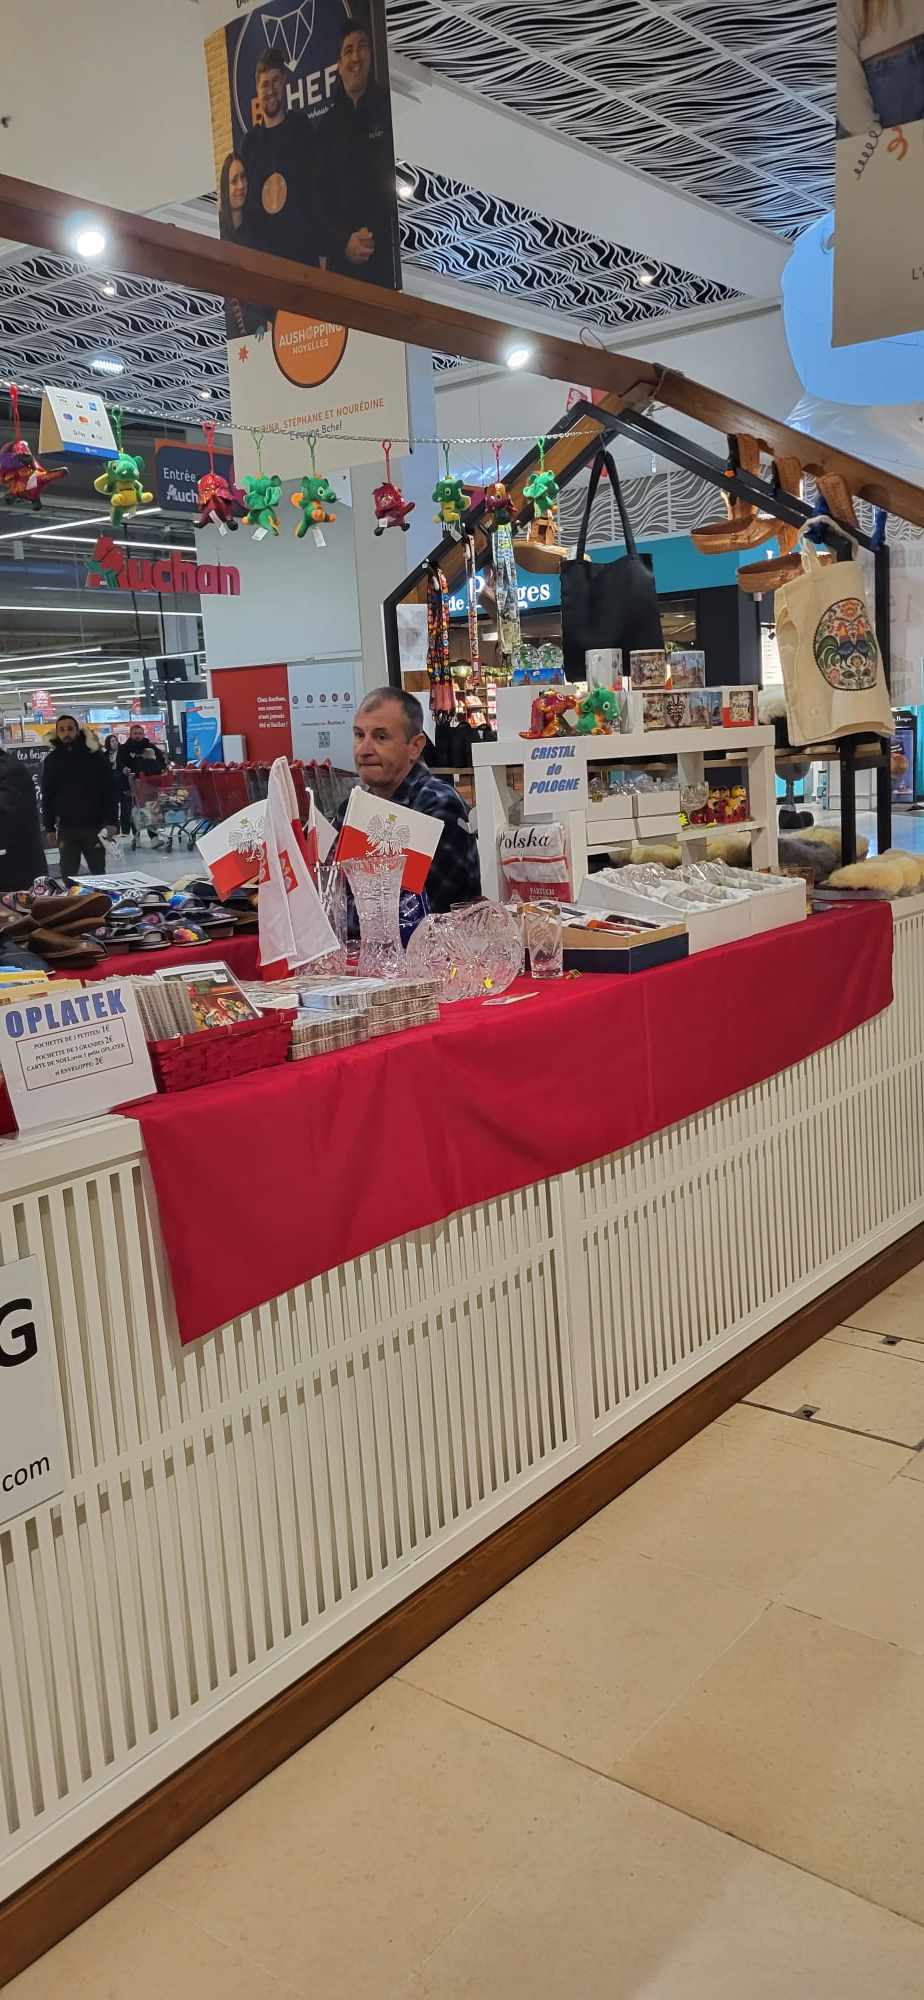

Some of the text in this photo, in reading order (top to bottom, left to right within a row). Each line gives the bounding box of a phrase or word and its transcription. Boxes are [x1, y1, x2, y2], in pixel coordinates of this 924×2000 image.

[292, 338, 329, 355] NOYELLES
[163, 466, 197, 482] Entrée
[166, 484, 198, 504] Auch
[85, 535, 241, 596] Auchan
[531, 745, 576, 760] CRISTAL
[546, 763, 562, 776] de
[529, 777, 580, 794] POLOGNE
[5, 988, 127, 1039] OPLATEK
